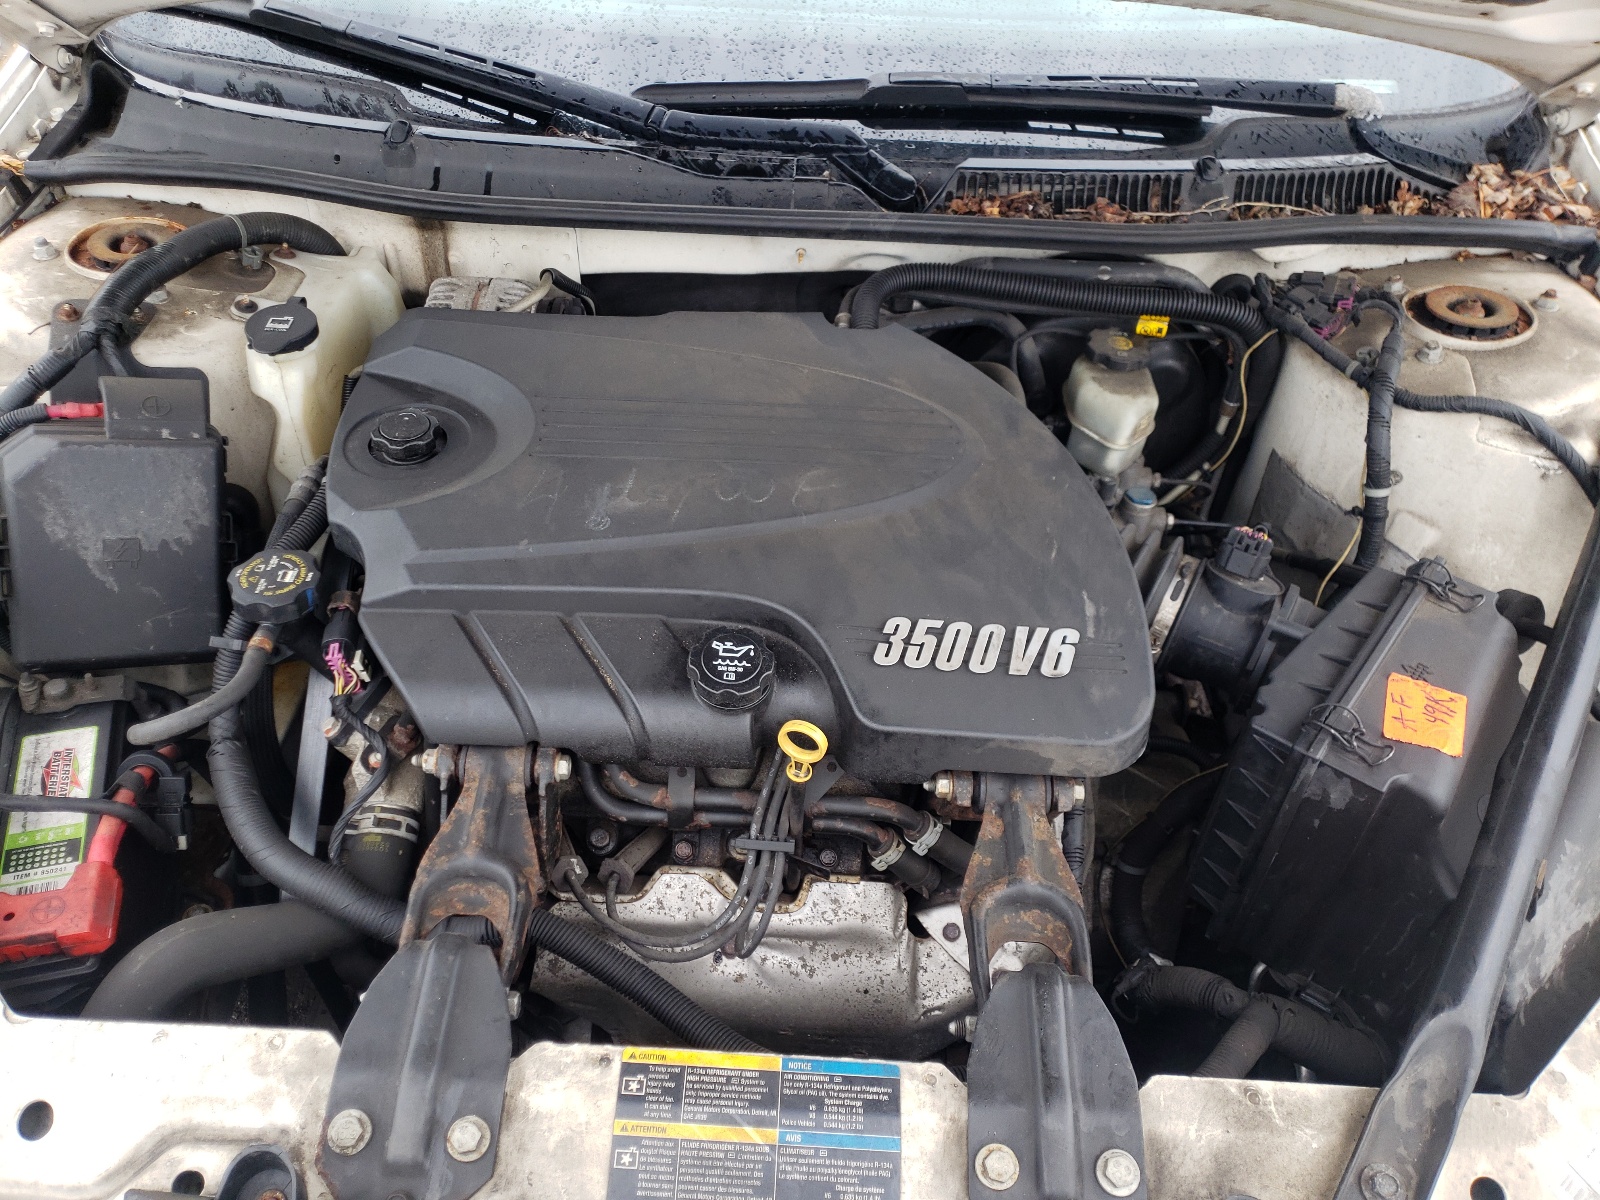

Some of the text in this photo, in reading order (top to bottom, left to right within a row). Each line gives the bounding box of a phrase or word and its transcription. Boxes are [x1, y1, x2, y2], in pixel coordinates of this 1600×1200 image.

[47, 750, 62, 796] BATTERIE
[58, 748, 74, 798] INTERSTAT
[13, 872, 30, 880] ITEM
[638, 1053, 667, 1061] CAUTION
[788, 1062, 812, 1070] NOTICE
[630, 1125, 667, 1134] ATTENTION
[786, 1134, 802, 1142] AVIS
